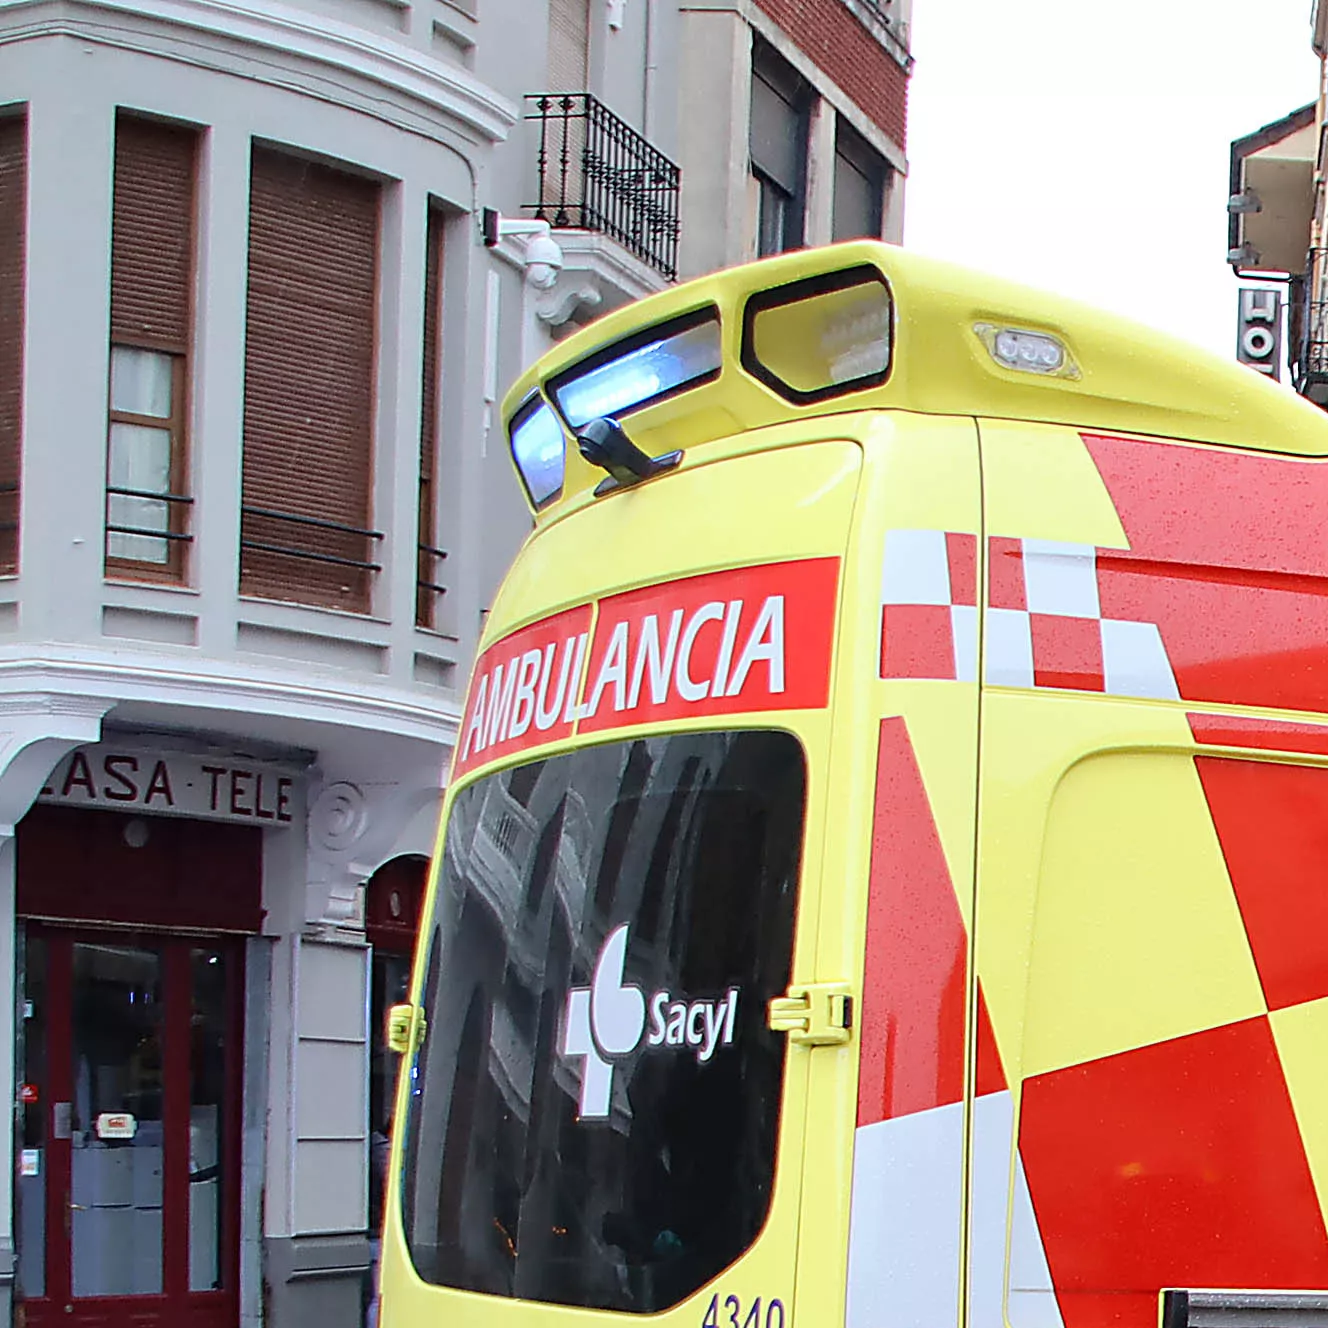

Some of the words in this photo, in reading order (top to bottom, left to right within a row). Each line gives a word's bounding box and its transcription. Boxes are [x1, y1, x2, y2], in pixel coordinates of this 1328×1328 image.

[461, 594, 785, 762] AMBULANCIA
[40, 751, 174, 806] ASA
[202, 764, 293, 822] TELE
[648, 988, 739, 1062] Sacyl
